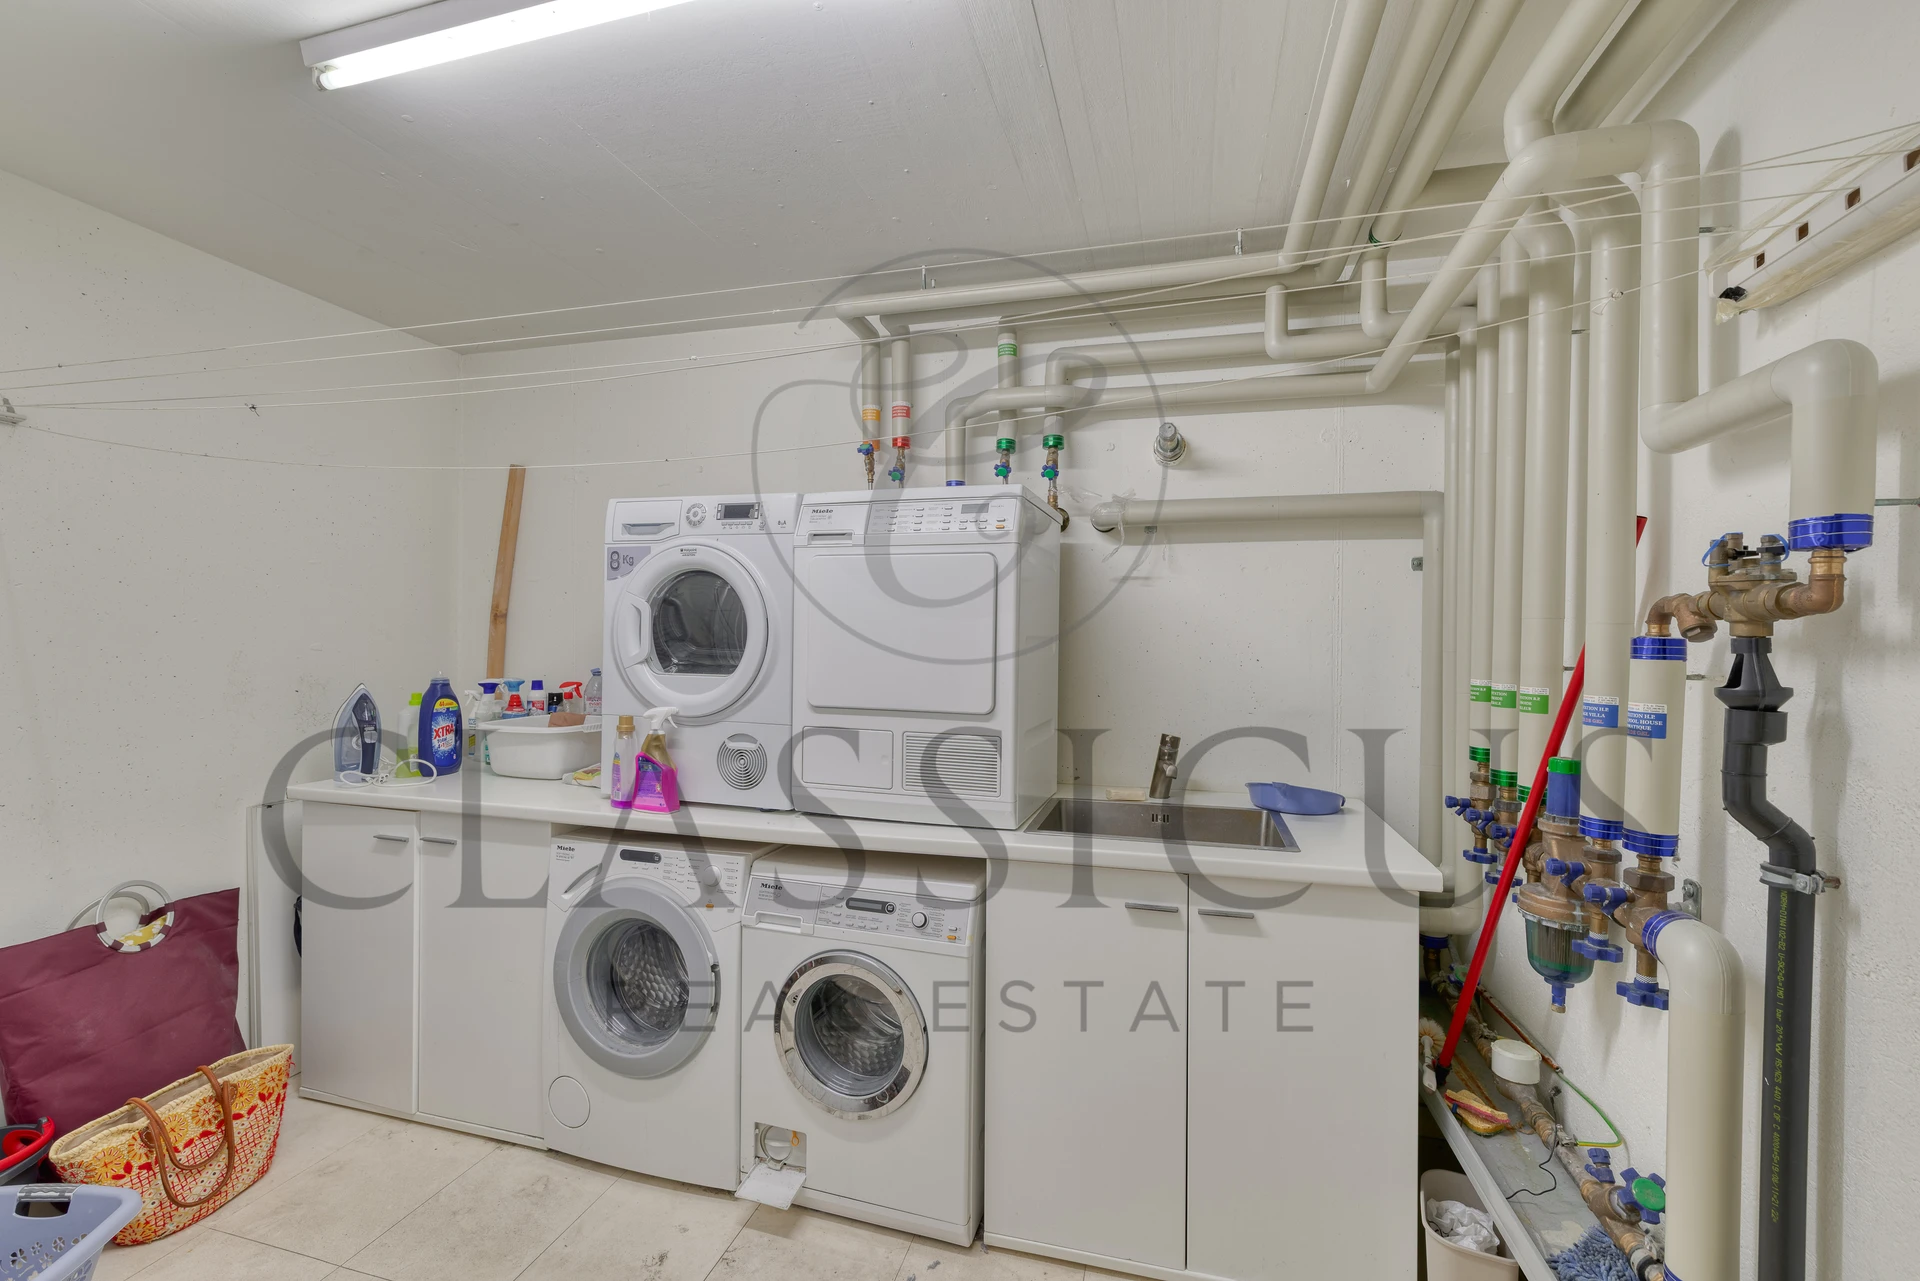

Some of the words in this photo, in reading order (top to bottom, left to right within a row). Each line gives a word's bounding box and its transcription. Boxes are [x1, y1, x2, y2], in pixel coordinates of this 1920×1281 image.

[610, 550, 620, 571] 8
[622, 554, 634, 567] Kg
[556, 844, 575, 852] Miele
[760, 882, 783, 890] Miele
[1775, 1008, 1783, 1022] bar
